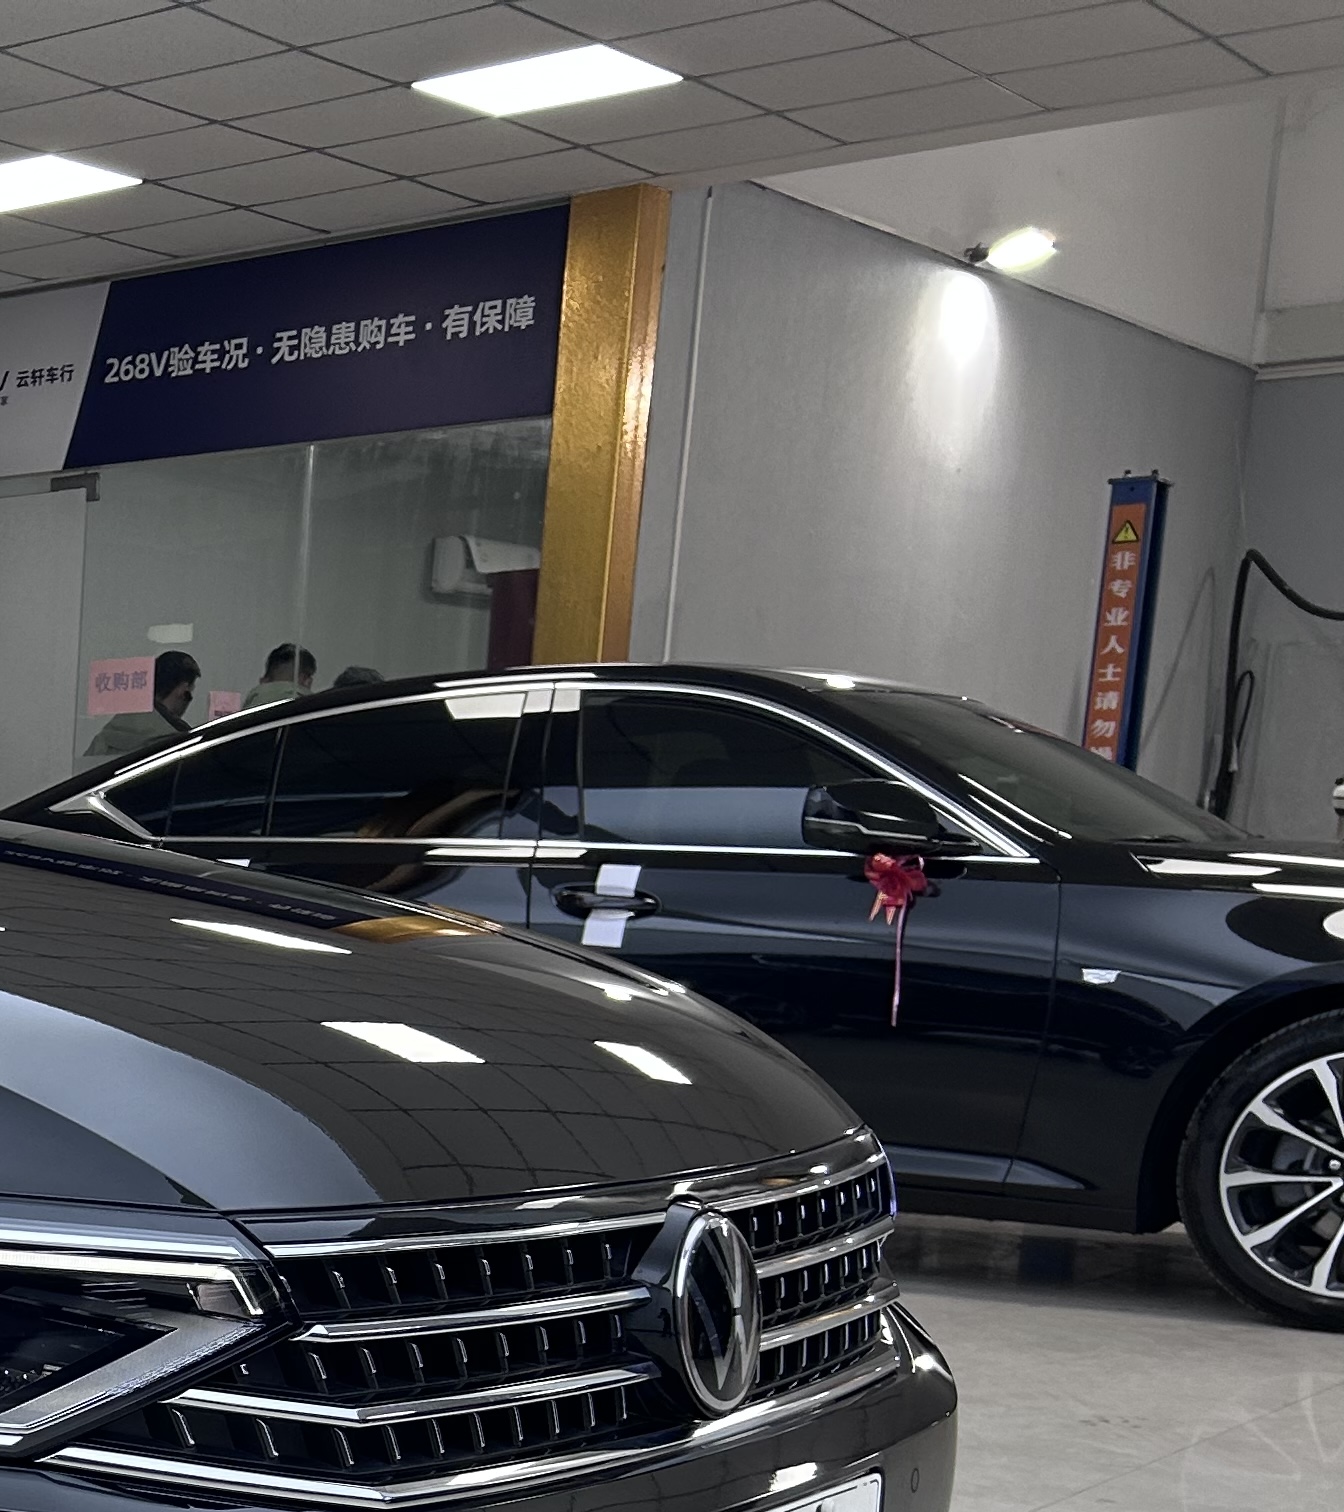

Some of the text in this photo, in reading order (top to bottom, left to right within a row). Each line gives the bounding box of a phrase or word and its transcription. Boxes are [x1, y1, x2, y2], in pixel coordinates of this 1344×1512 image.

[16, 363, 75, 389] 云轩车行
[94, 669, 149, 693] 收购部
